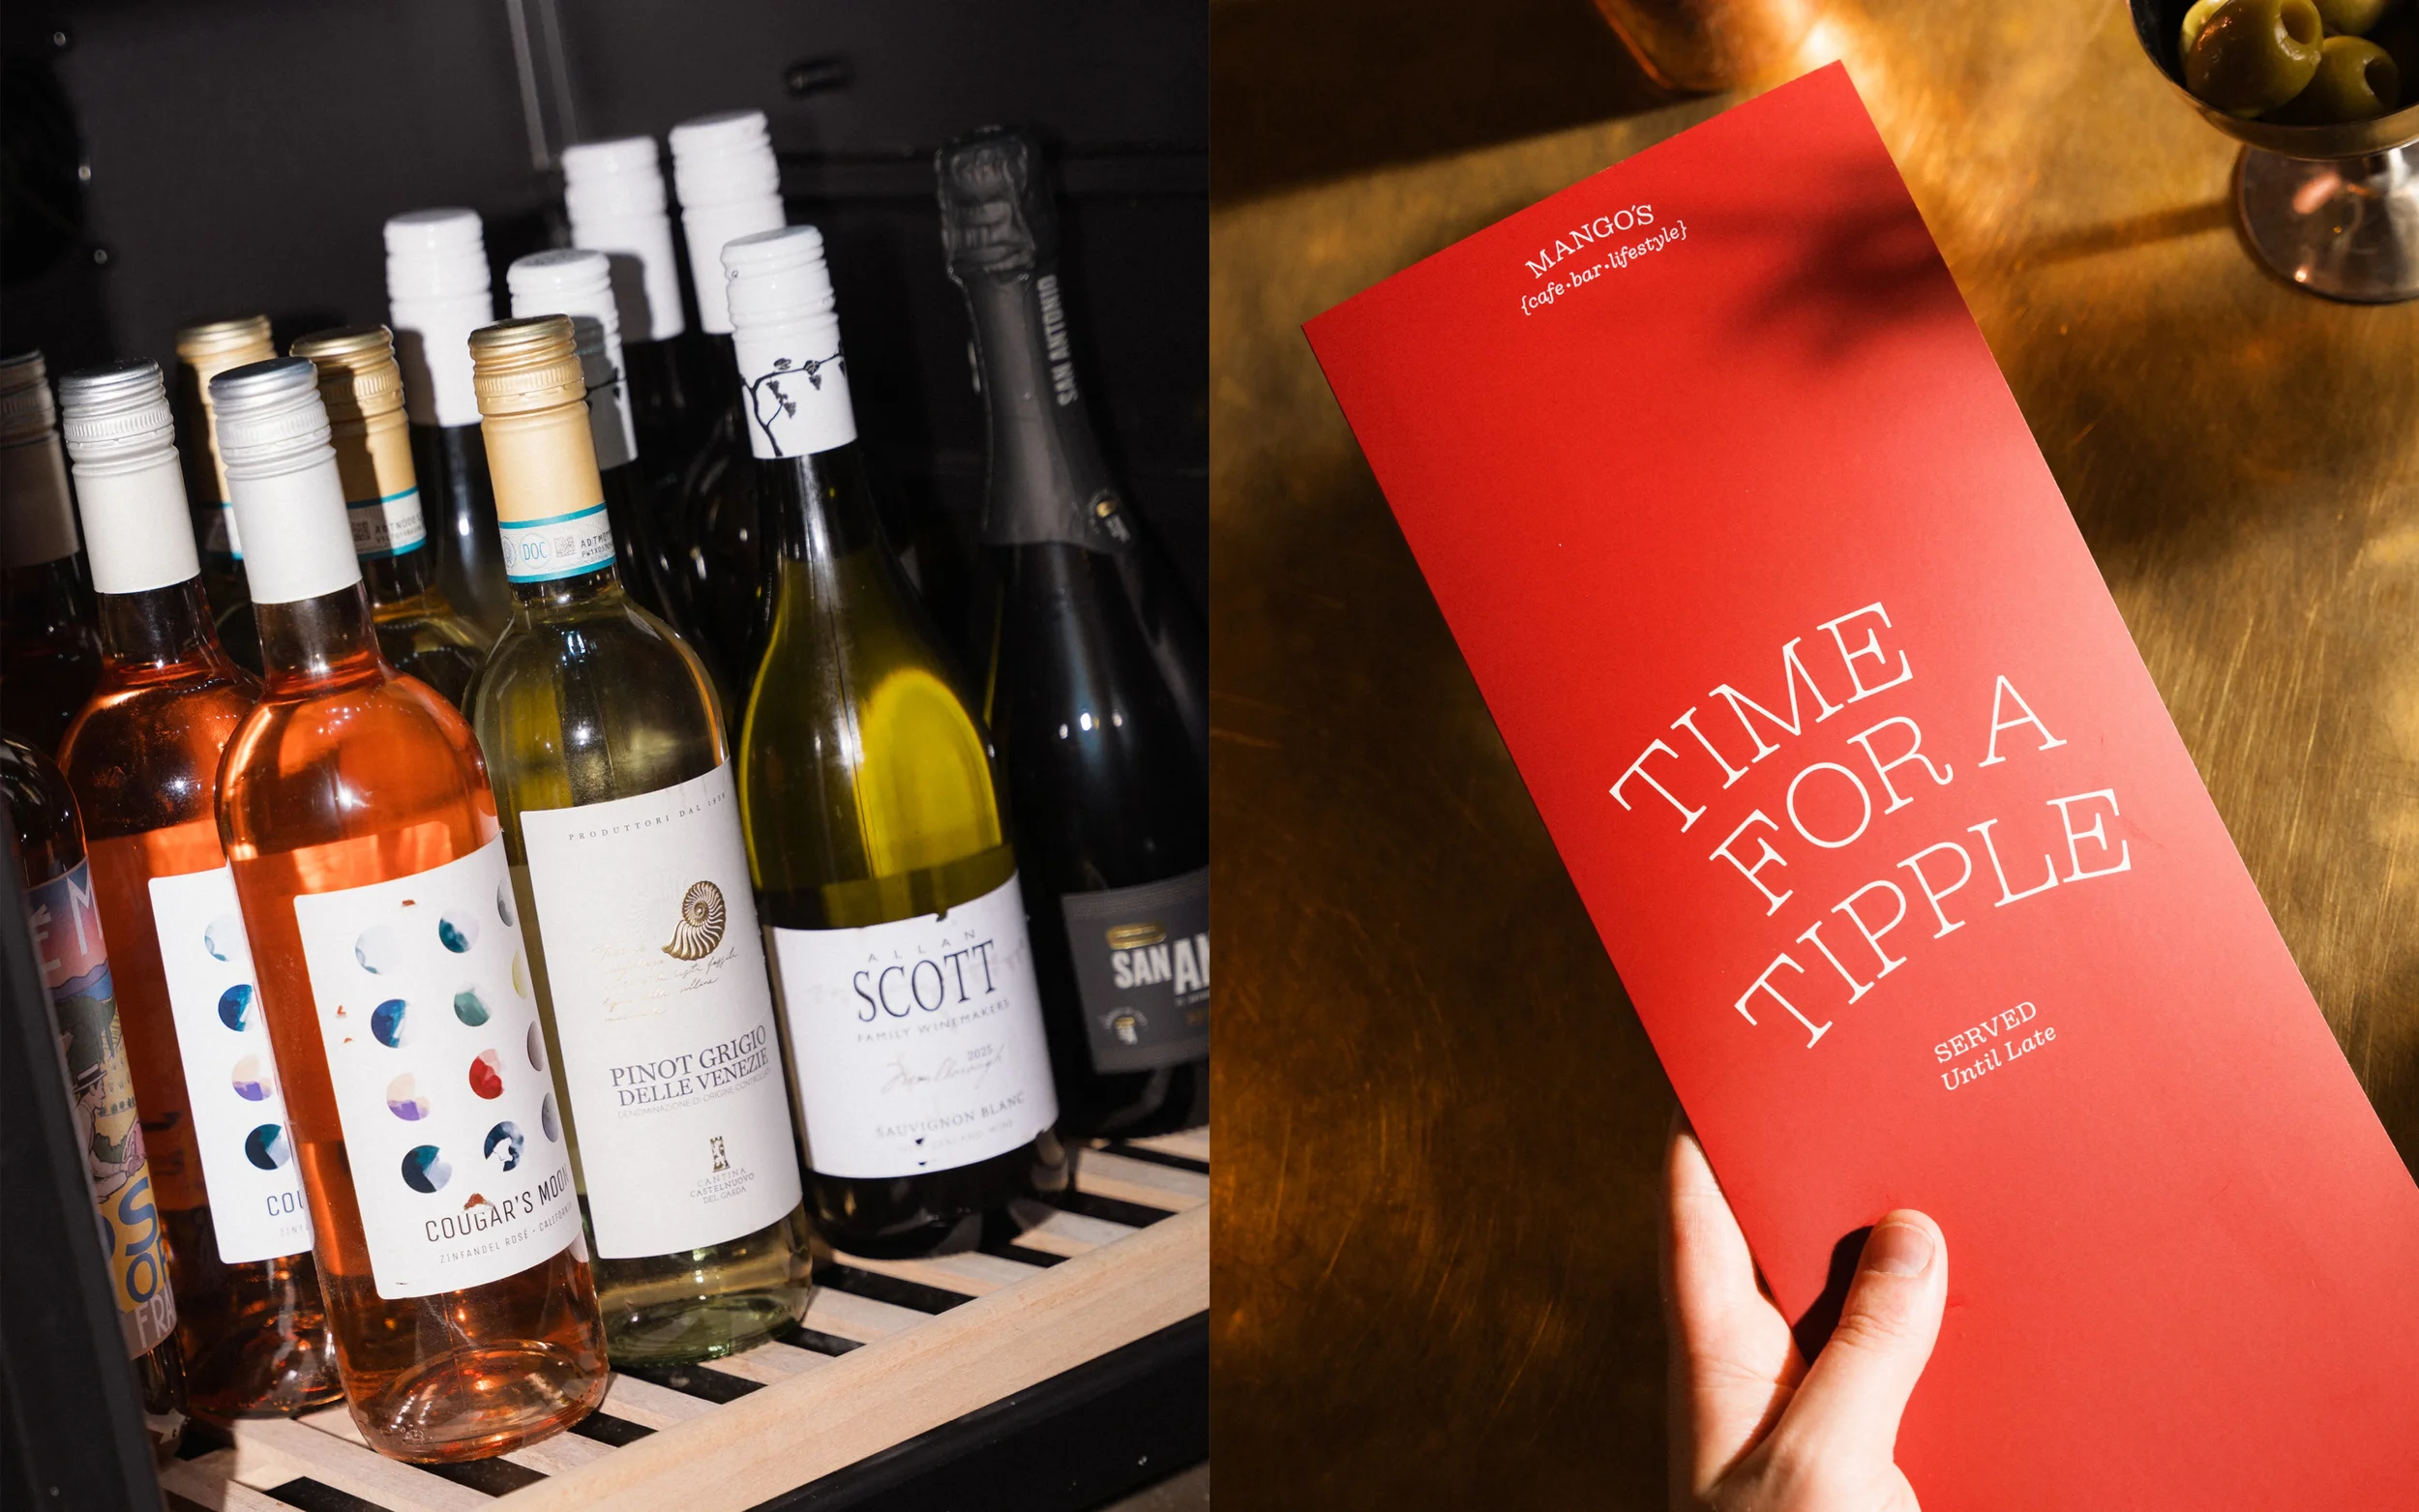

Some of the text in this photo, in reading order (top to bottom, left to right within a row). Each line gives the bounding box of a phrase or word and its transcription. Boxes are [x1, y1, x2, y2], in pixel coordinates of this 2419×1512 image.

[1525, 205, 1654, 278] MANGO'S
[1035, 274, 1078, 406] SAN ANTONIO
[523, 541, 548, 561] DOC
[1610, 602, 1913, 832] TIME
[569, 815, 670, 841] PRODUTTORI
[679, 804, 702, 817] DAL
[1710, 675, 2067, 916] FOR A
[1735, 788, 2131, 1048] TIPPLE
[868, 930, 975, 963] ALLAN
[1111, 943, 1173, 989] SAN
[853, 938, 997, 1023] SCOTT
[857, 998, 1010, 1043] FAMILY WINEMAKERS
[1933, 1001, 2037, 1064] SERVED
[609, 1024, 766, 1087] PINOT GRIGIO
[618, 1047, 769, 1107] DELLE VENEZIE
[1940, 1024, 2056, 1090] Until Late
[617, 1098, 691, 1119] DENOMINAZIONE
[693, 1094, 702, 1106] DI
[702, 1085, 734, 1103] ORIGINE
[876, 1090, 1026, 1139] SAUVIGNON BLANC
[425, 1163, 569, 1242] COUGAR'S MOON
[690, 1172, 755, 1198] CASTELNUOVO
[697, 1168, 746, 1187] CANTINA
[702, 1186, 747, 1204] DEL GARDA
[439, 1241, 501, 1263] ZINFANDEL
[504, 1228, 529, 1246] ROSÉ
